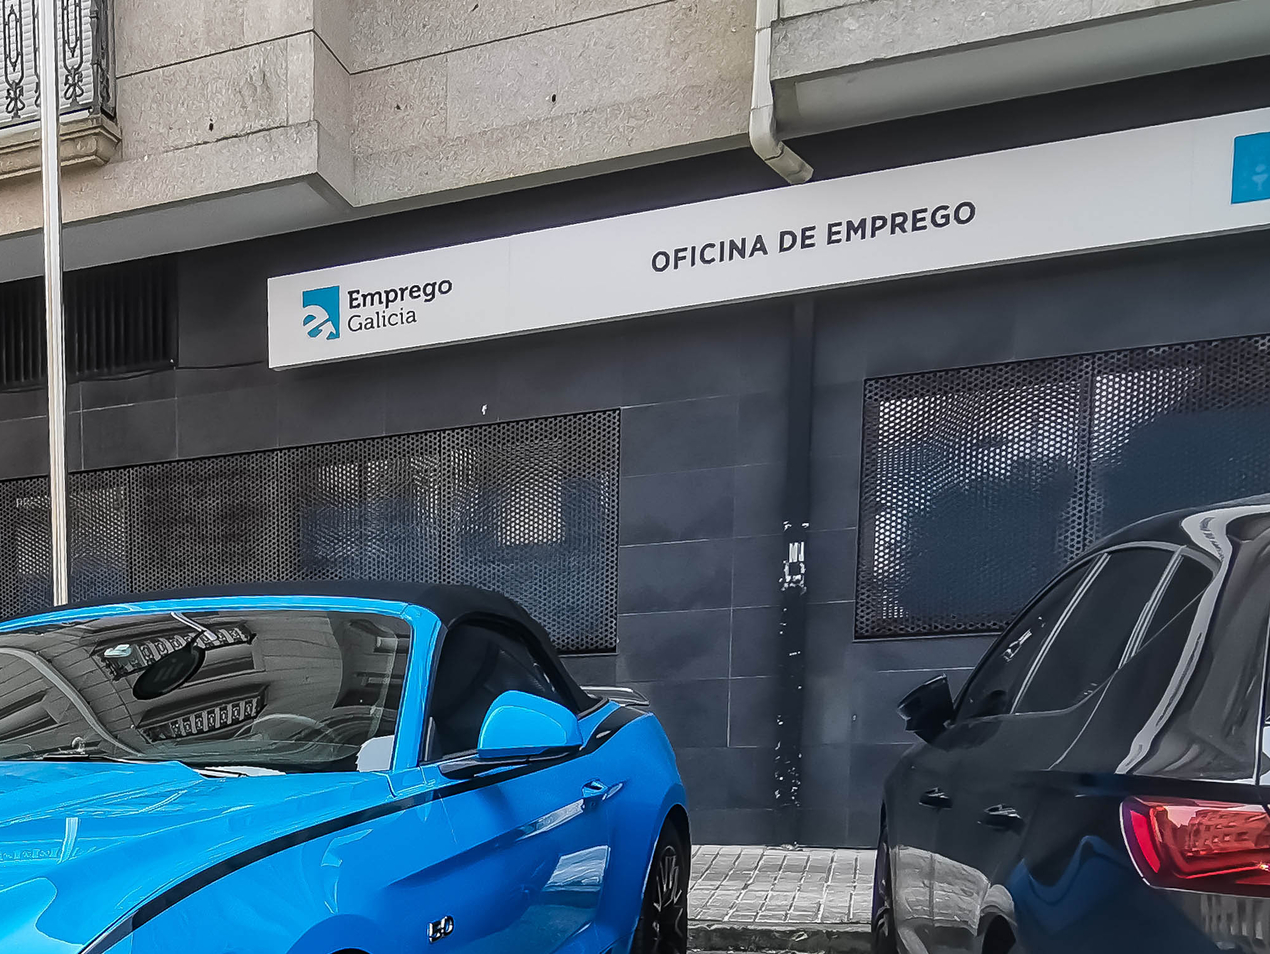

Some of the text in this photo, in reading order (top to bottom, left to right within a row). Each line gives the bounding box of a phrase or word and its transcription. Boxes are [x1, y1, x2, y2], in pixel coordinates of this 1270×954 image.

[651, 201, 976, 273] OFICINA DE EMPREGO
[348, 279, 453, 309] Emprego
[348, 308, 417, 333] Galicia
[428, 915, 454, 943] 5.0
